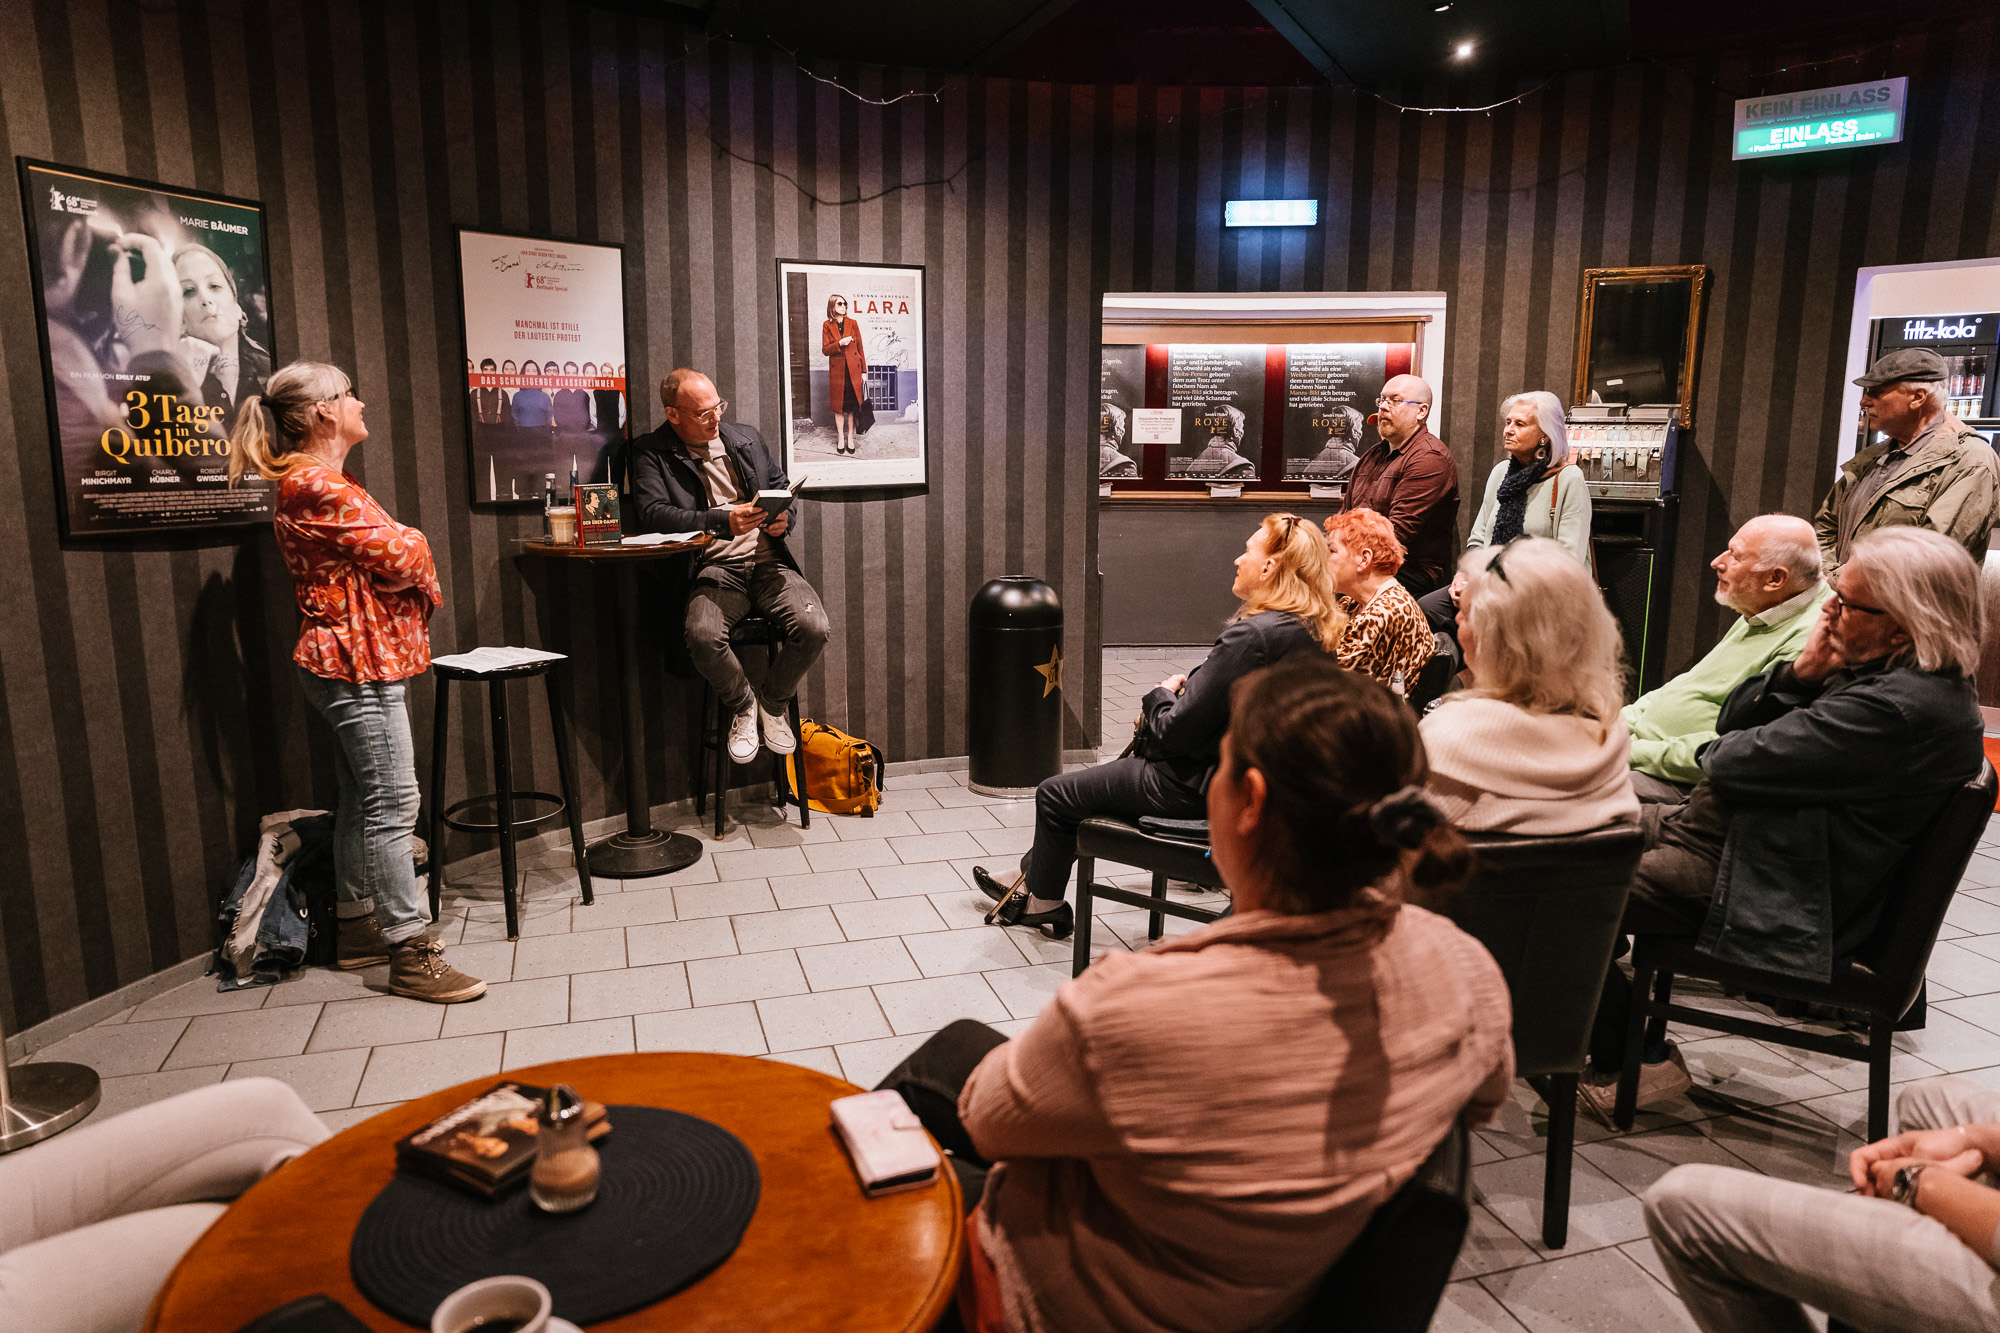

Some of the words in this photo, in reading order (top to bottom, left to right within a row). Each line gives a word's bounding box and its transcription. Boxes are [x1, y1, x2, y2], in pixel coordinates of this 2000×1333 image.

[1745, 102, 1792, 119] KEIN
[1800, 87, 1891, 109] EINLASS
[1770, 120, 1859, 144] EINLASS
[180, 216, 209, 229] MARIE
[210, 221, 248, 235] BÄUMER
[853, 300, 909, 315] LARA
[515, 320, 549, 330] MANCHMAL
[550, 322, 560, 330] IST
[561, 323, 579, 332] STILLE
[514, 331, 526, 340] DER
[527, 332, 555, 341] LAUTESTE
[556, 333, 581, 342] PROTEST
[481, 376, 496, 385] DAS
[499, 377, 553, 386] SCHWEIGENDE
[555, 378, 615, 388] KLASSENZIMMER
[126, 390, 151, 430] 3
[153, 394, 225, 434] Tage
[1195, 418, 1228, 426] ROSE
[1312, 419, 1346, 427] ROSE
[176, 424, 190, 437] in
[101, 427, 232, 465] Quibero
[81, 477, 132, 486] MINICHMAYR
[150, 475, 180, 484] HÜBNER
